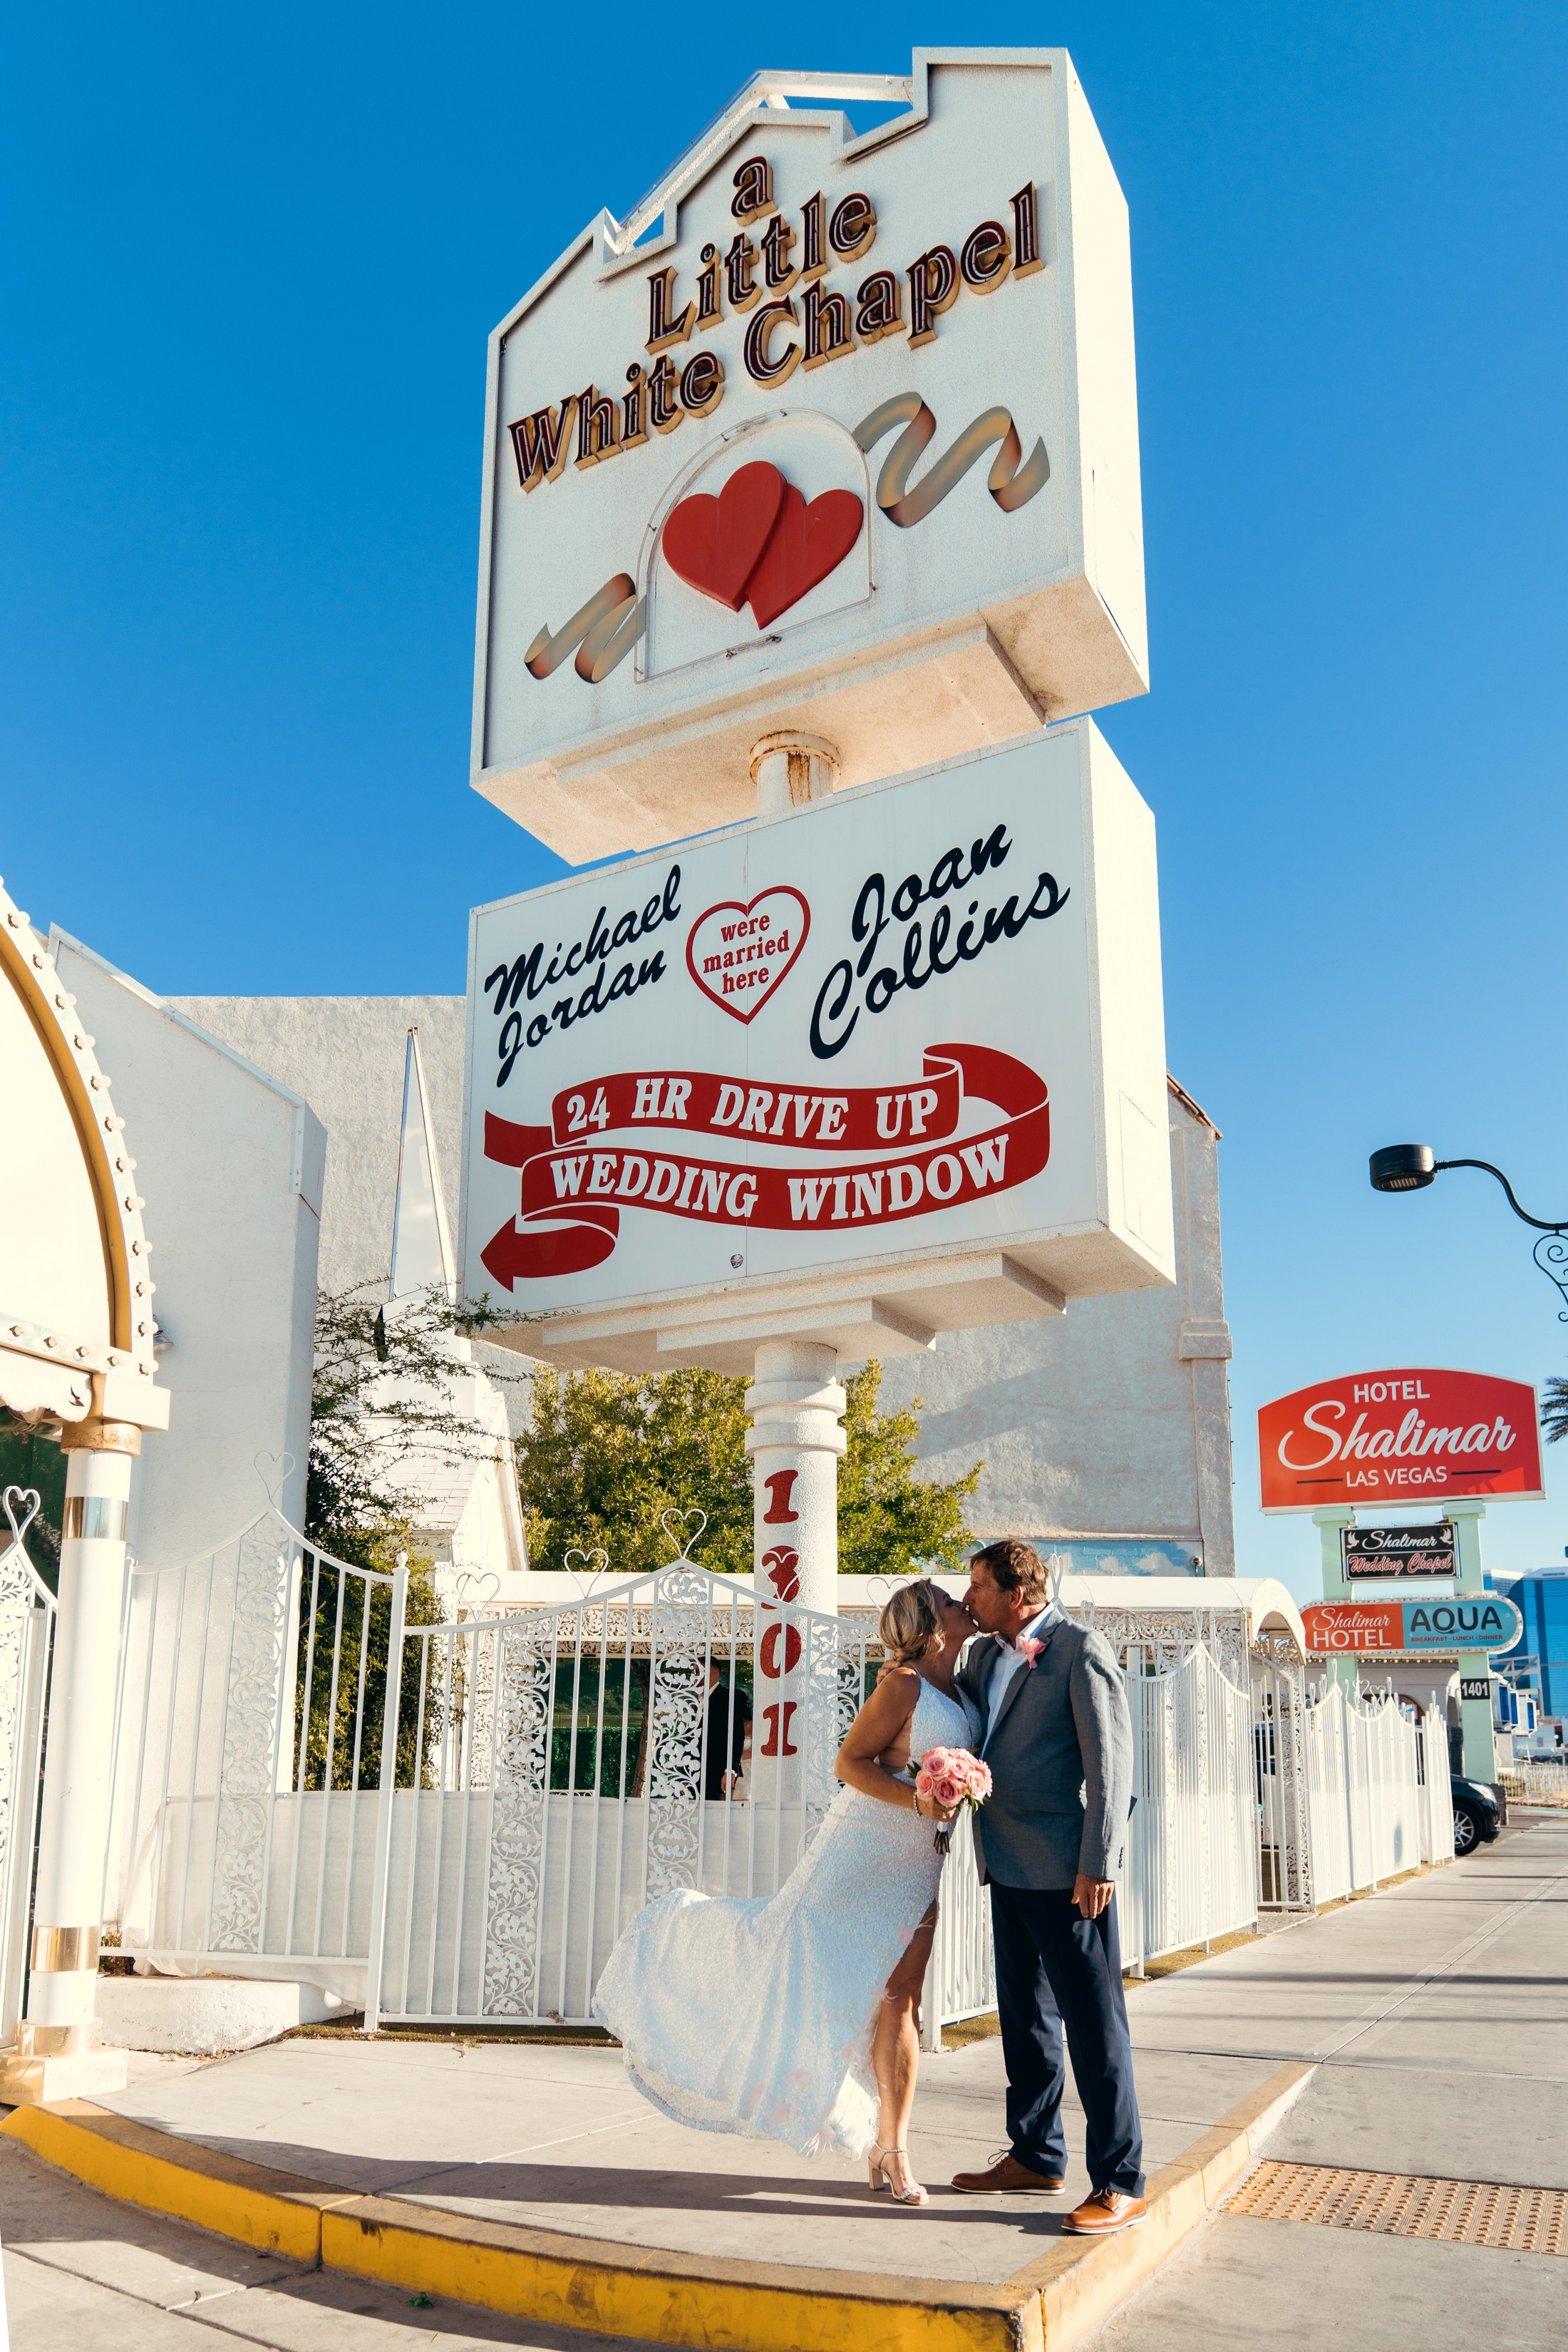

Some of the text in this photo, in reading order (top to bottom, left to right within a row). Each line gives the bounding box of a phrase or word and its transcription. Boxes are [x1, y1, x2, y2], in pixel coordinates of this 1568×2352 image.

[731, 156, 778, 226] a
[644, 189, 877, 354] Little
[507, 180, 1044, 493] White Chapel
[852, 824, 1011, 975] Joan
[484, 864, 681, 1015] Michael
[703, 929, 790, 974] married
[721, 914, 770, 942] were
[722, 966, 769, 994] here
[809, 872, 1070, 1059] Collins
[497, 950, 666, 1088] Jordan
[567, 1078, 939, 1140] 24 HR DRIVE UP
[550, 1134, 1009, 1221] WEDDING WINDOW
[1354, 1380, 1430, 1403] HOTEL
[1278, 1400, 1516, 1470] Shalimar
[1346, 1466, 1448, 1487] LAS VEGAS
[1348, 1552, 1452, 1576] Wedding Chapel
[1361, 1530, 1438, 1549] Shalimar
[760, 1469, 801, 1757] 1301
[1313, 1608, 1391, 1631] Shalimar
[1314, 1629, 1391, 1648] HOTEL
[1410, 1606, 1502, 1632] AQUA
[1462, 1681, 1488, 1697] 1401
